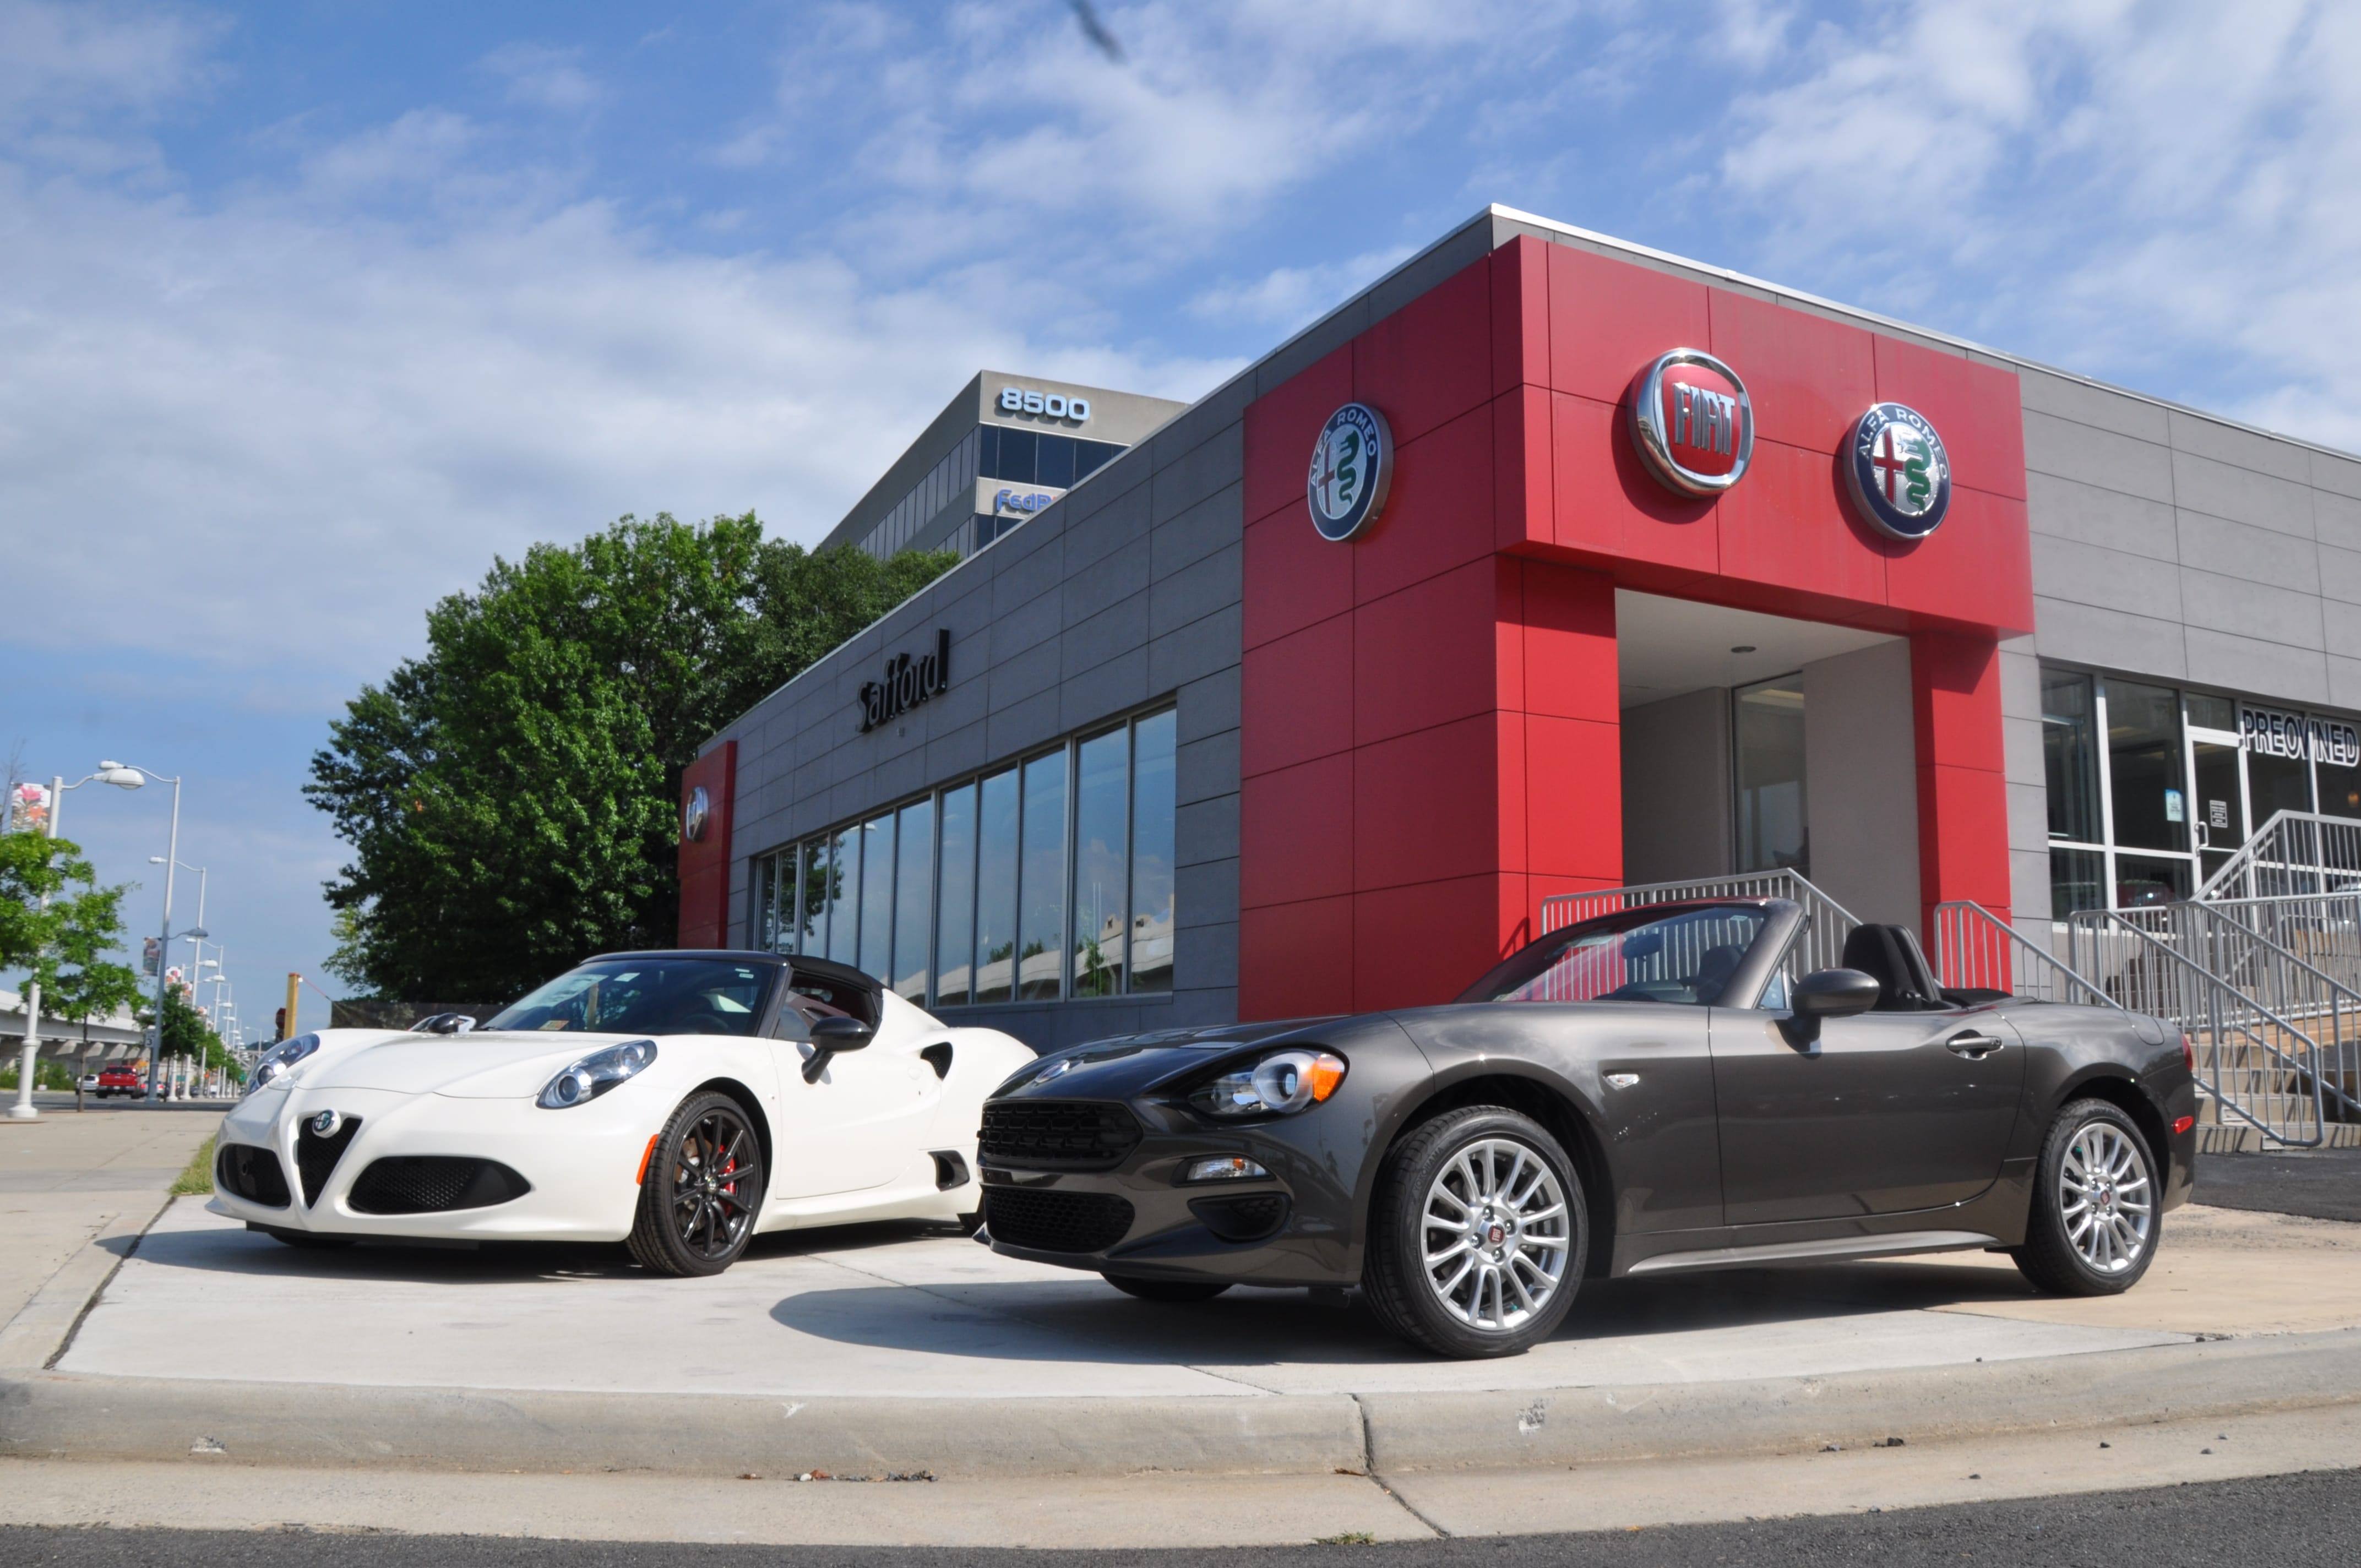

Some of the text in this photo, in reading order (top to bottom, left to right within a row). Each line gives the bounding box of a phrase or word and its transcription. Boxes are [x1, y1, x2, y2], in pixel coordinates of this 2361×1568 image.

[1002, 387, 1091, 421] 8500
[1673, 382, 1736, 456] FIAT
[1310, 408, 1377, 487] ALFA ROMEO
[1858, 407, 1947, 480] ALFA ROMEO
